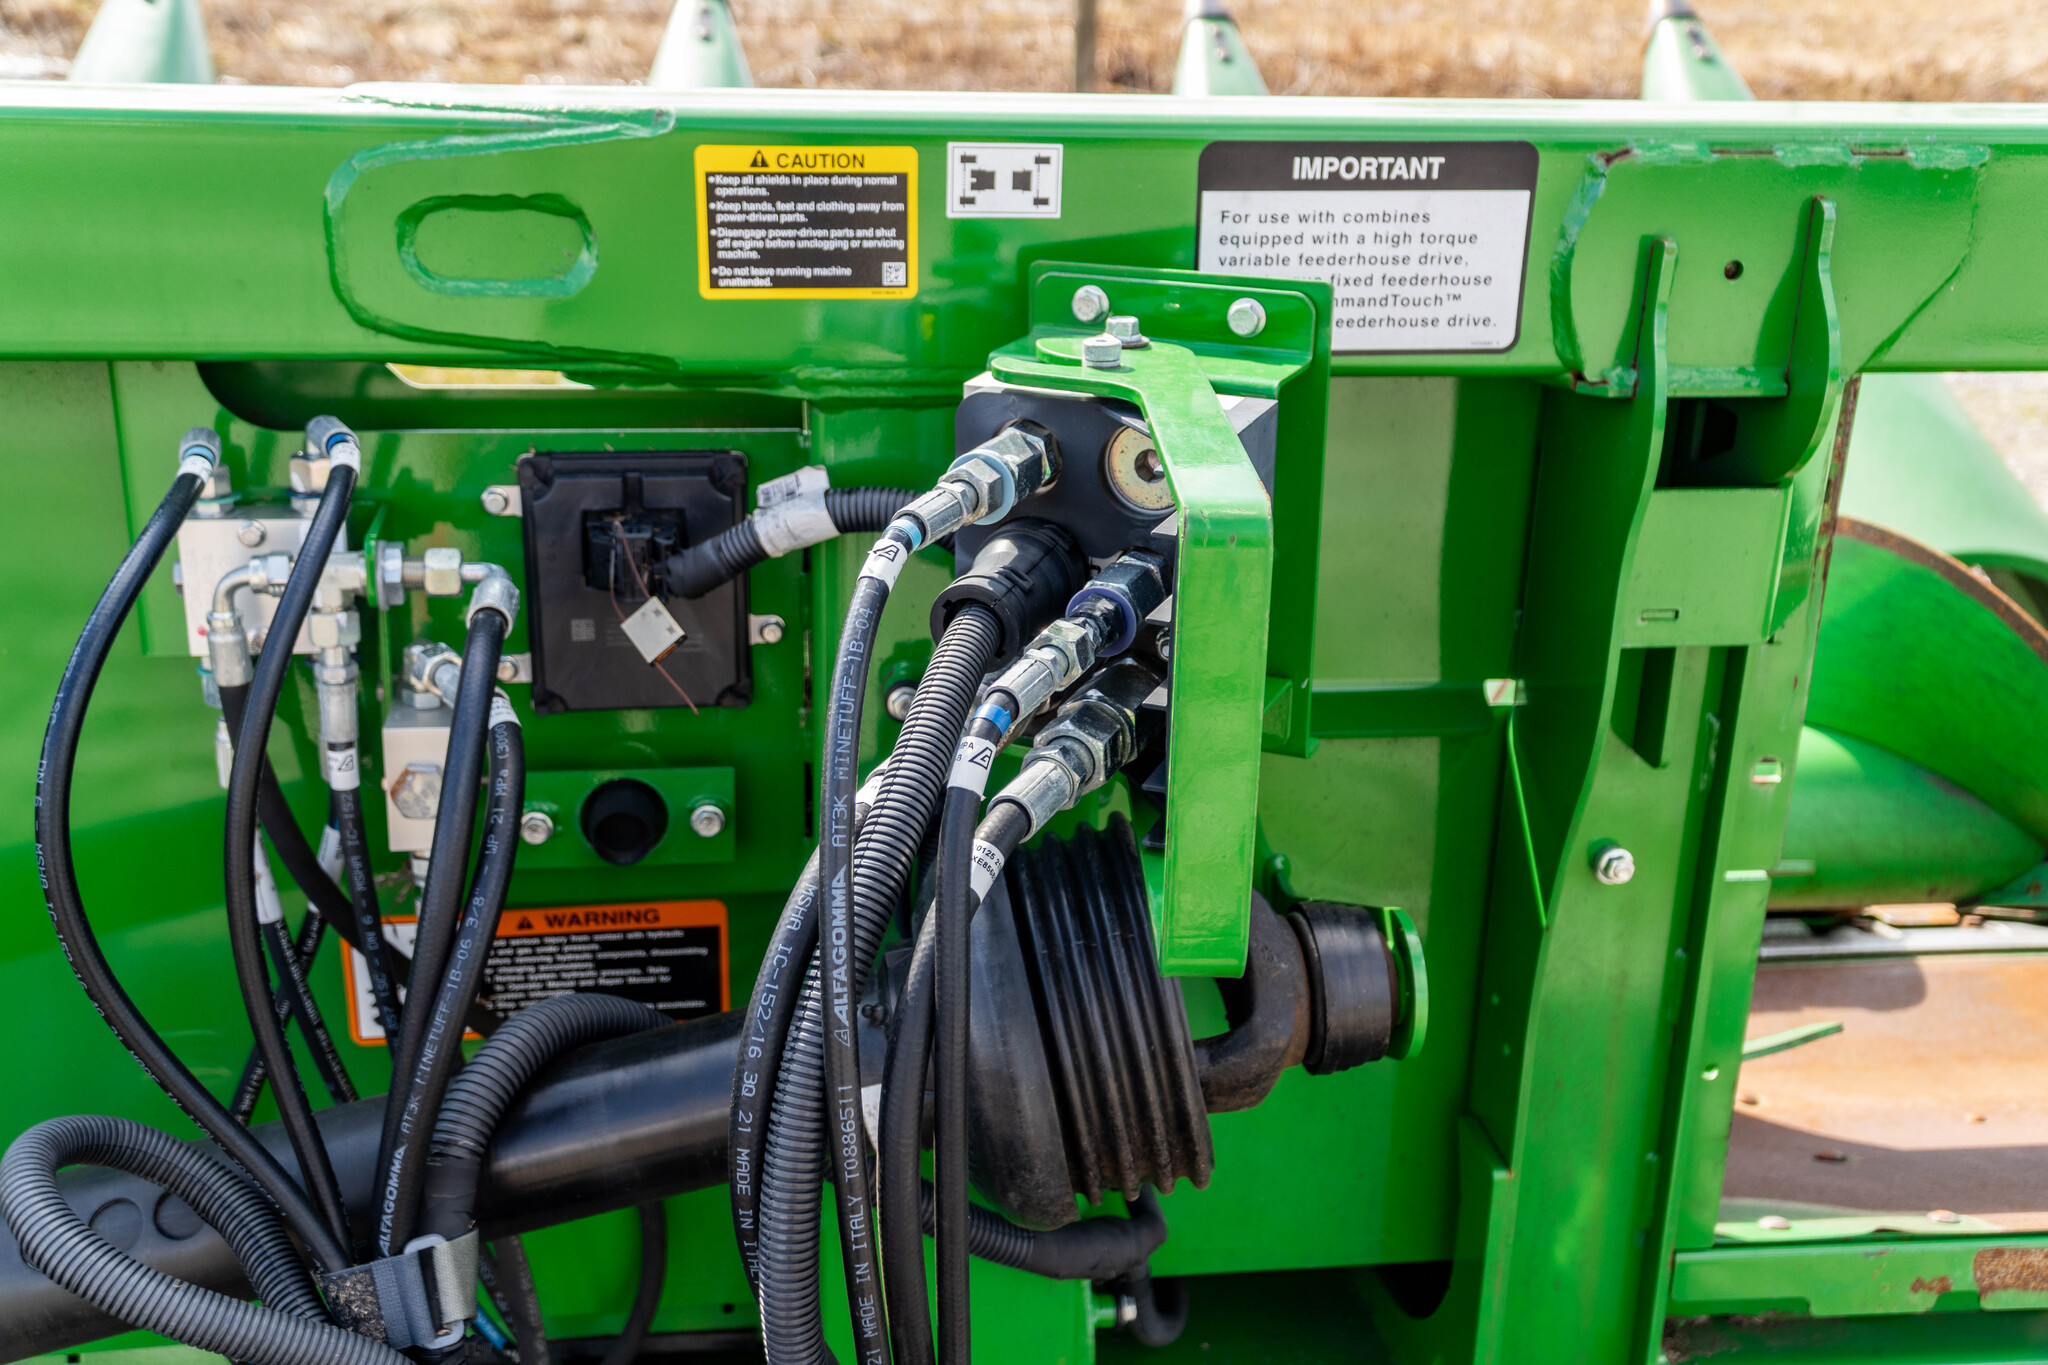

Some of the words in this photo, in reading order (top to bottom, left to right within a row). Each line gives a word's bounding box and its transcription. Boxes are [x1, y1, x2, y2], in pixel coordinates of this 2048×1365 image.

[776, 153, 865, 169] CAUTION
[1292, 156, 1446, 180] IMPORTANT
[715, 175, 740, 187] Keep
[741, 175, 754, 185] all
[755, 175, 790, 185] shields
[792, 175, 802, 185] in
[803, 175, 830, 187] place
[831, 175, 862, 188] during
[863, 175, 897, 186] normal
[715, 186, 770, 198] operations.
[715, 201, 741, 212] Keep
[742, 201, 775, 212] hands,
[776, 201, 795, 211] feet
[796, 201, 815, 211] and
[816, 201, 855, 213] clothing
[856, 203, 881, 213] away
[882, 202, 905, 211] from
[1221, 209, 1250, 224] For
[1258, 212, 1290, 224] use
[1298, 210, 1336, 224] with
[1343, 210, 1431, 224] combines
[716, 213, 778, 224] power-driven
[780, 213, 808, 224] parts.
[717, 227, 767, 239] Disengage
[768, 227, 828, 238] power-driven
[830, 227, 854, 238] parts
[856, 227, 873, 237] and
[875, 227, 896, 237] shut
[1219, 232, 1304, 247] equipped
[1312, 231, 1349, 245] with
[1356, 234, 1365, 245] a
[1373, 231, 1412, 248] high
[1420, 232, 1478, 248] torque
[717, 239, 731, 249] off
[732, 239, 764, 250] engine
[765, 239, 795, 249] before
[797, 239, 849, 250] unclogging
[850, 240, 861, 249] or
[862, 239, 904, 250] servicing
[717, 249, 760, 259] machine.
[1219, 253, 1291, 267] variable
[1298, 252, 1411, 267] feederhouse
[1418, 252, 1469, 268] drive,
[718, 266, 732, 276] Do
[733, 266, 750, 276] not
[750, 266, 775, 276] leave
[776, 266, 812, 278] running
[813, 266, 852, 276] machine
[718, 277, 773, 287] unattended.
[1330, 272, 1374, 287] fixed
[1382, 273, 1493, 287] feederhouse
[1336, 314, 1440, 328] eederhouse
[1448, 314, 1497, 328] drive.
[833, 606, 874, 781] MINETUFF-1B-04
[494, 768, 509, 796] MPa
[490, 807, 505, 825] 21
[831, 793, 850, 848] AT3K
[485, 833, 499, 854] WP
[545, 908, 661, 927] WARNING
[788, 883, 817, 931] MSHA
[831, 864, 850, 1027] ALFAGOMMA
[748, 943, 793, 1059] IC-152/16
[741, 1071, 759, 1097] 3Q
[401, 1095, 423, 1134] AT3K
[737, 1110, 753, 1133] 21
[838, 1084, 860, 1182] T0886511
[735, 1148, 751, 1196] MADE
[378, 1145, 407, 1259] ALFAGOMMA
[738, 1208, 753, 1229] IN
[847, 1195, 868, 1251] ITALY
[855, 1262, 872, 1284] IN
[858, 1295, 879, 1338] MADE
